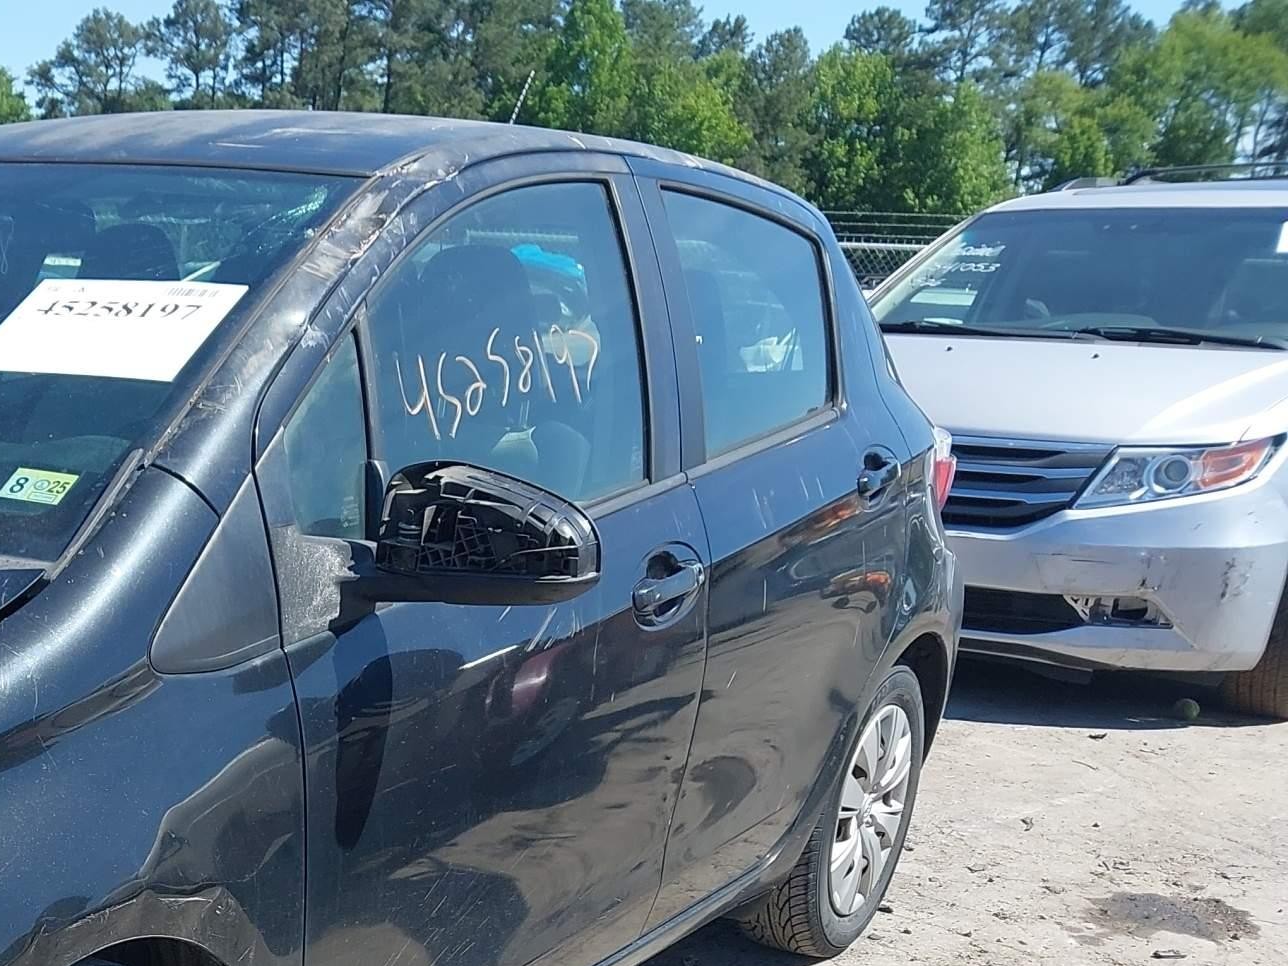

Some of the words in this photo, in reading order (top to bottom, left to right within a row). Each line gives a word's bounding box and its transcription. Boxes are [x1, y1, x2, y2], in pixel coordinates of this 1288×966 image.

[37, 300, 202, 320] 45258197
[395, 324, 599, 441] 45258197
[9, 477, 29, 493] 8
[46, 480, 71, 494] 25
